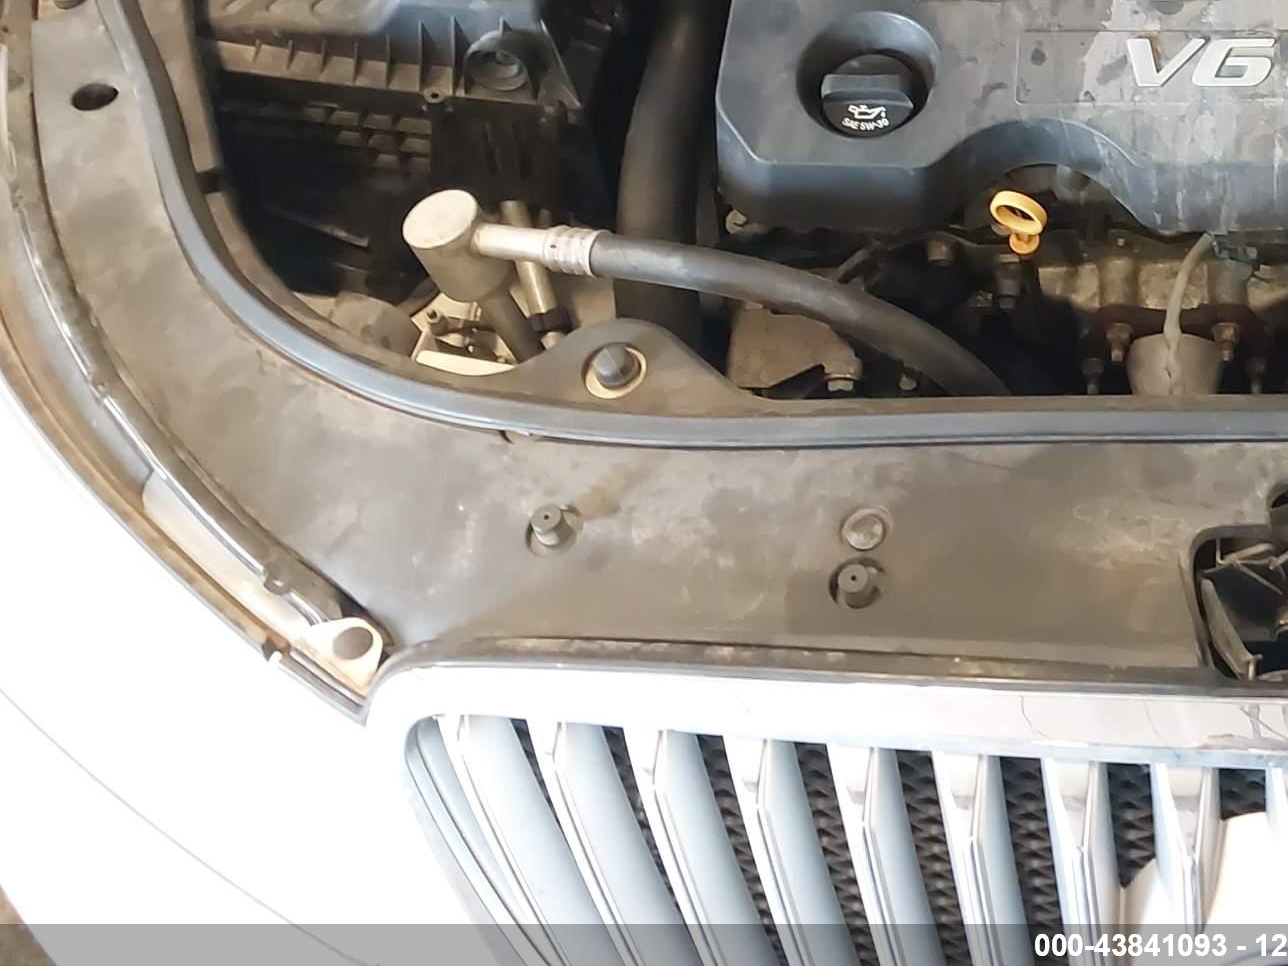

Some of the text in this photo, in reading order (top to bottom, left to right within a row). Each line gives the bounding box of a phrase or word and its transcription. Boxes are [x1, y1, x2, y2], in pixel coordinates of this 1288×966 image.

[1127, 37, 1277, 87] V6
[842, 117, 889, 131] SAE 5W-30
